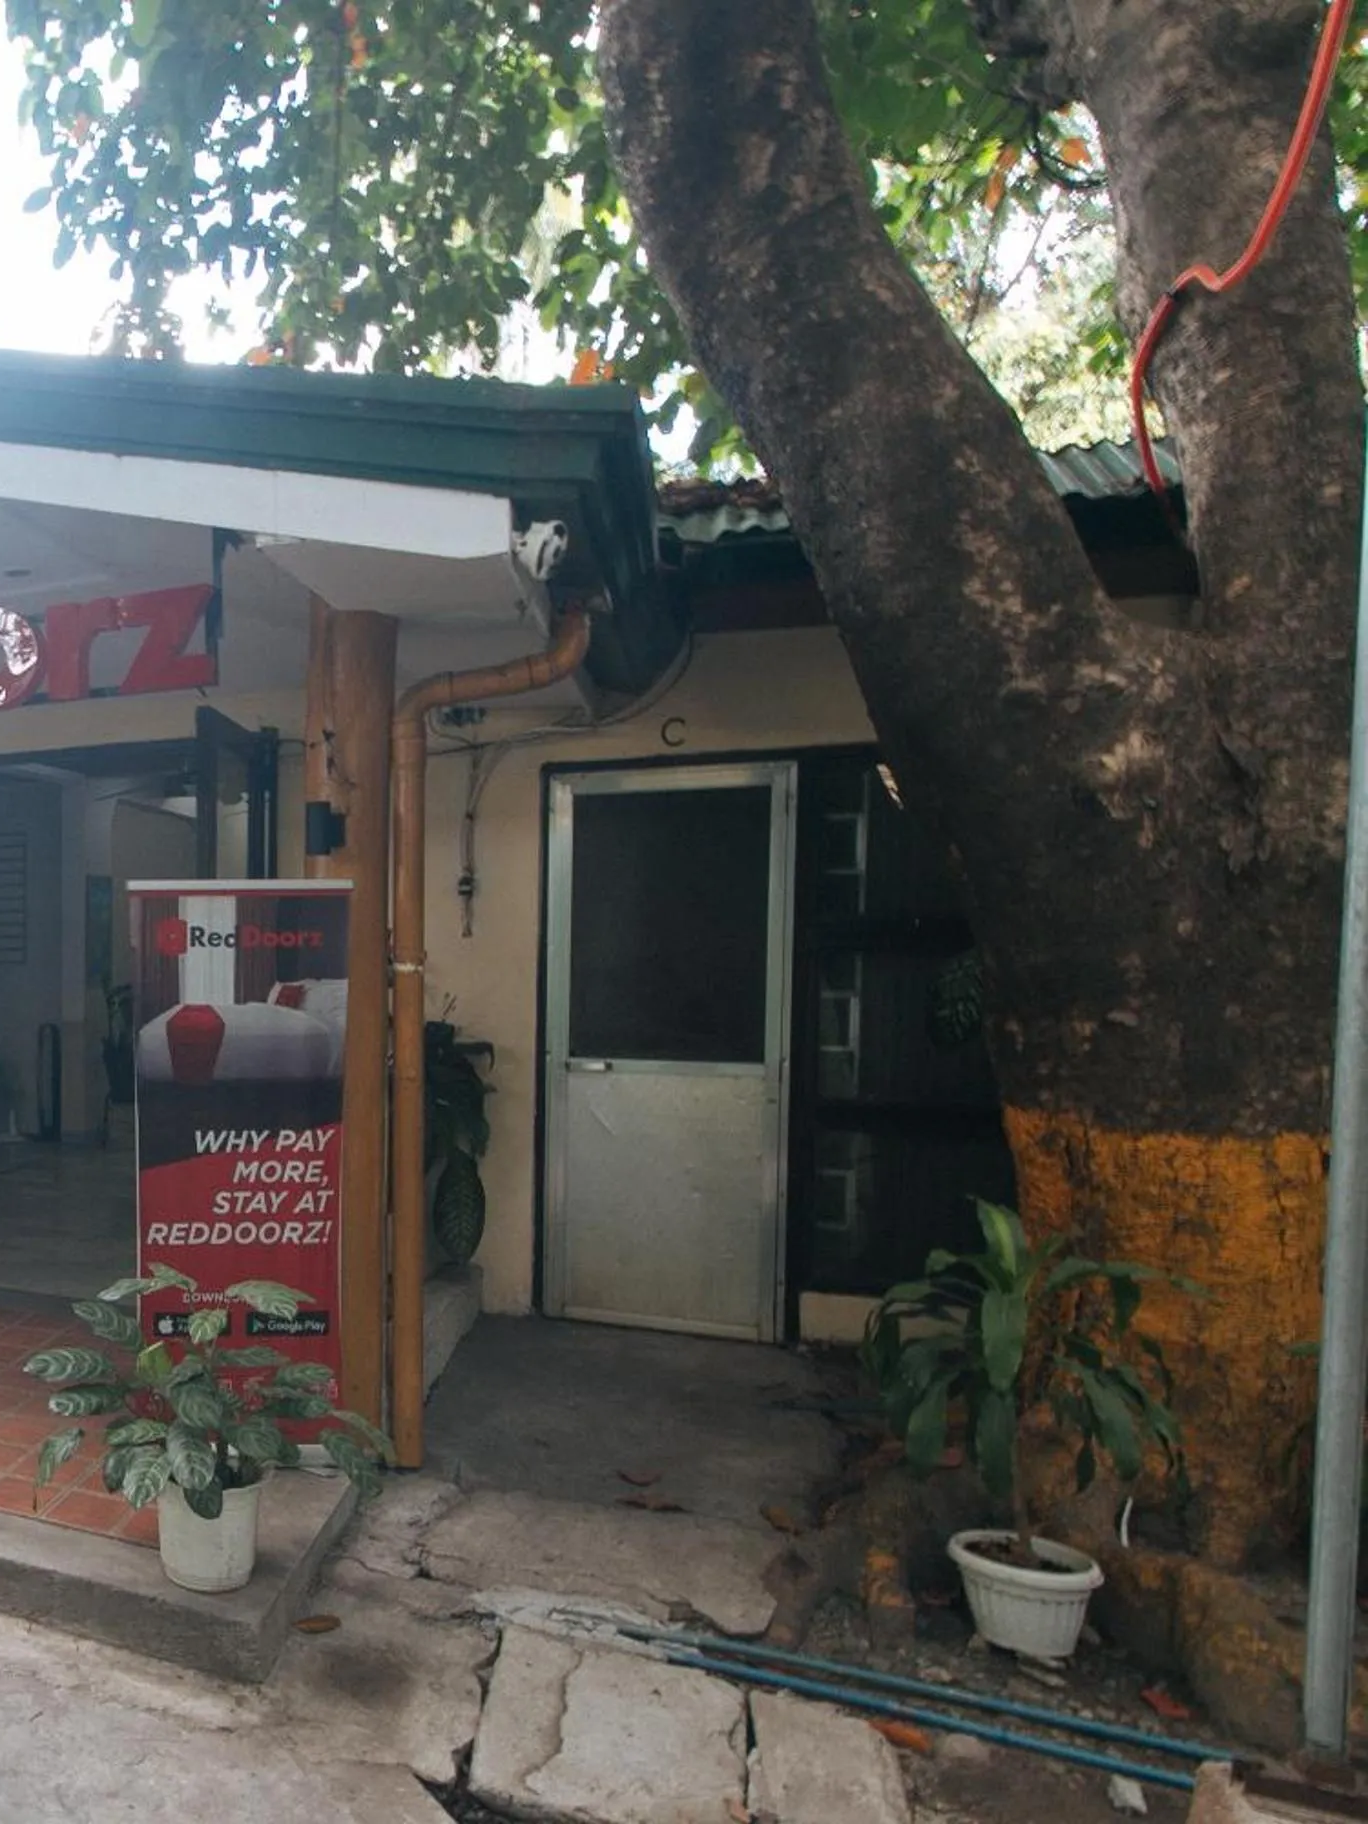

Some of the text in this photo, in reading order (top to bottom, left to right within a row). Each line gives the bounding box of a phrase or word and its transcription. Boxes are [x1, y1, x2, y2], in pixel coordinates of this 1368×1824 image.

[660, 716, 686, 748] C
[189, 924, 324, 949] RedDoorz
[194, 1129, 334, 1153] WHY PAY
[232, 1160, 328, 1187] MORE,
[212, 1190, 334, 1215] STAY AT
[146, 1221, 333, 1246] REDDOORZ!
[267, 1318, 326, 1333] Google Play
